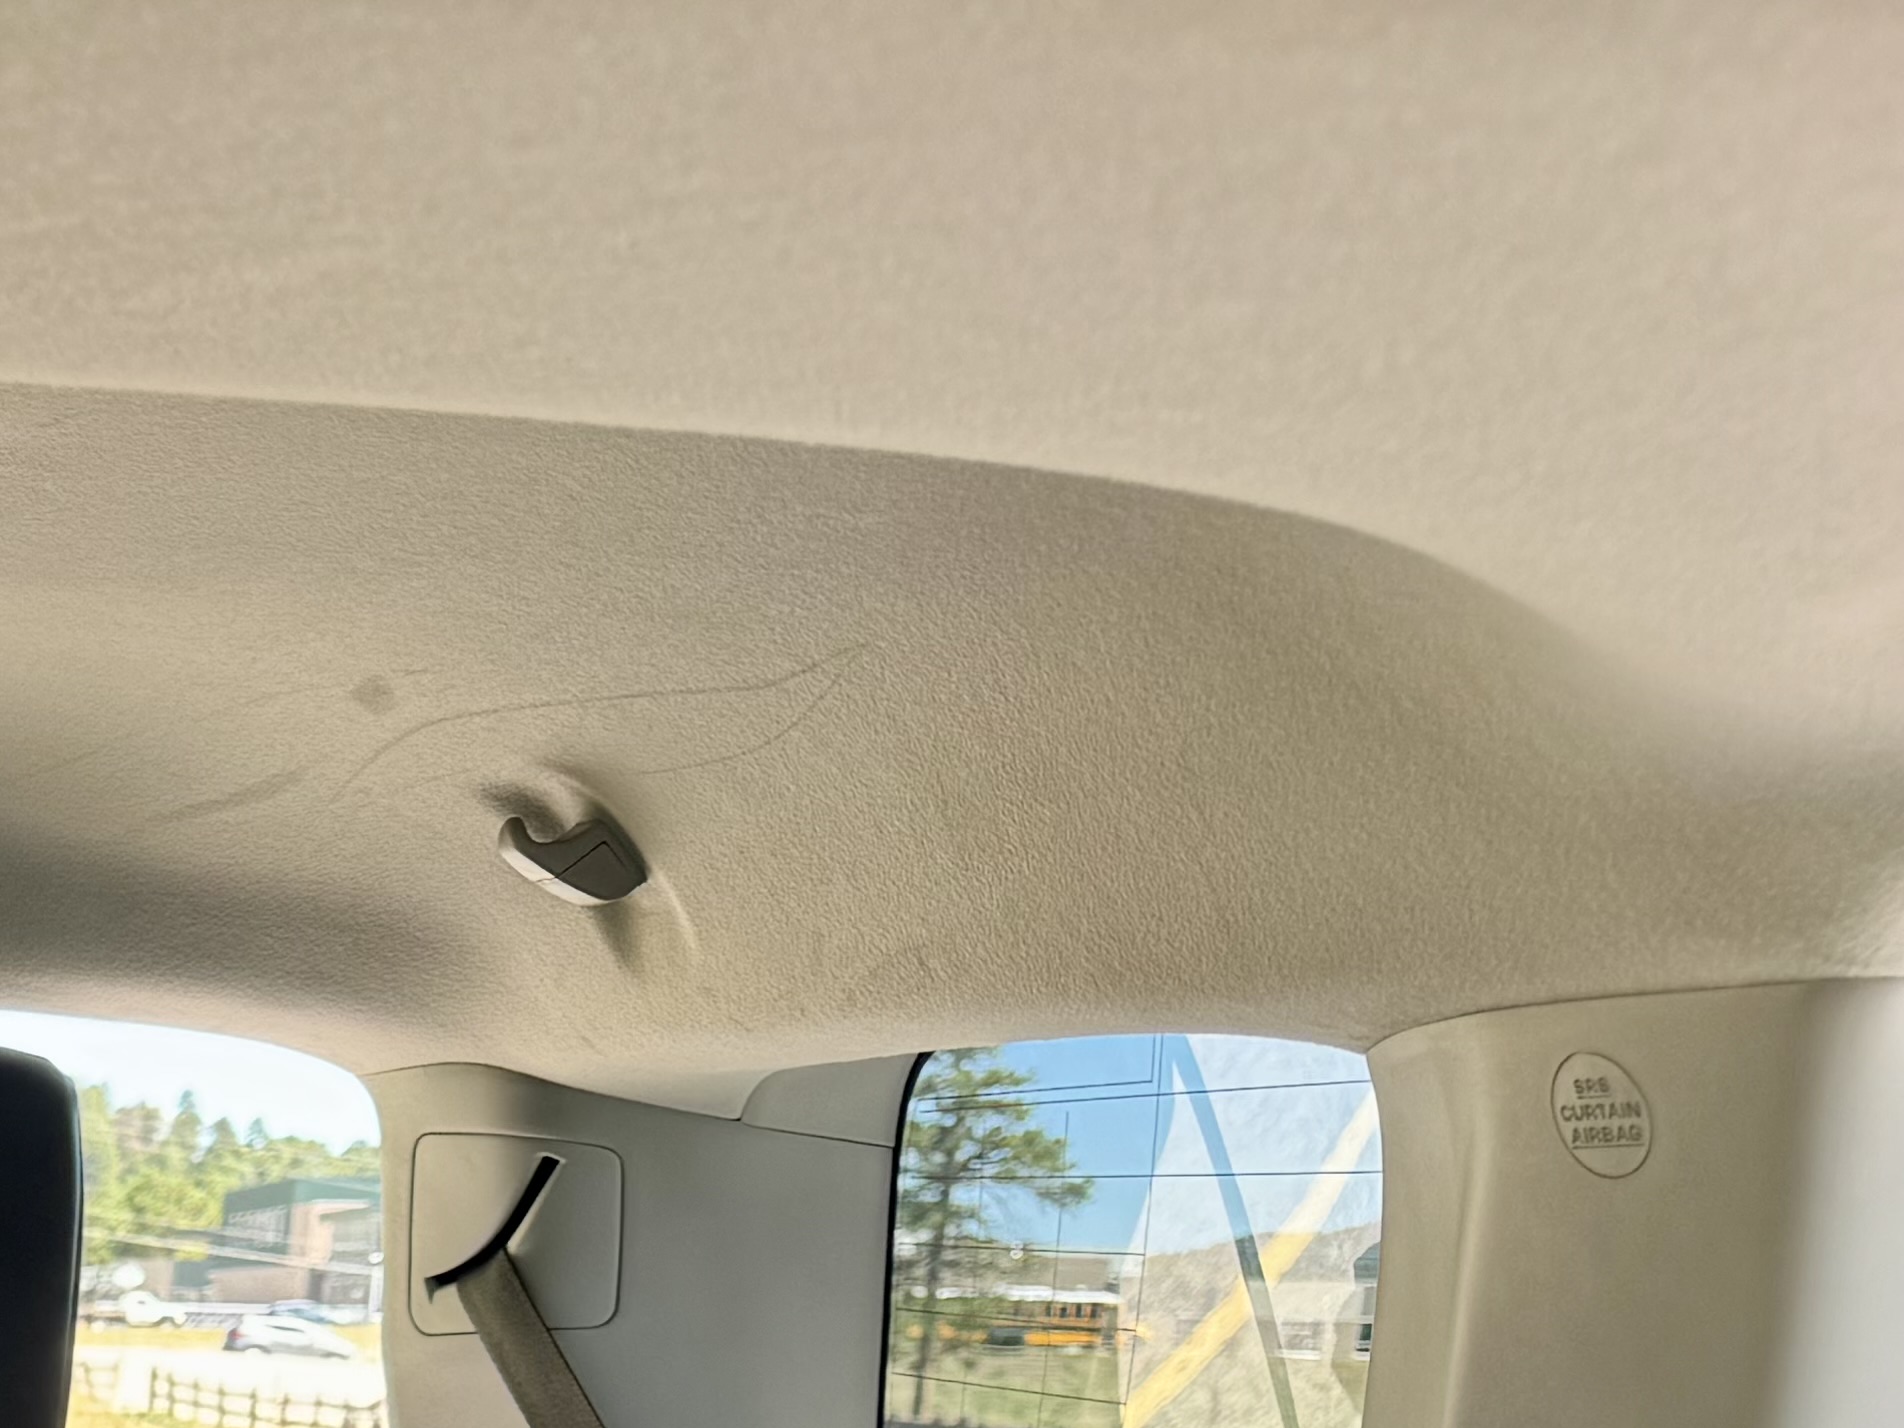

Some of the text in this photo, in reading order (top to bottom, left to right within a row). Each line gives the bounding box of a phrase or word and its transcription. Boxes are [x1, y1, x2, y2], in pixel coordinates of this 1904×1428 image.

[1573, 1076, 1611, 1094] SRS
[1559, 1101, 1642, 1123] CURTAIN
[1571, 1124, 1643, 1144] AIRBAG
